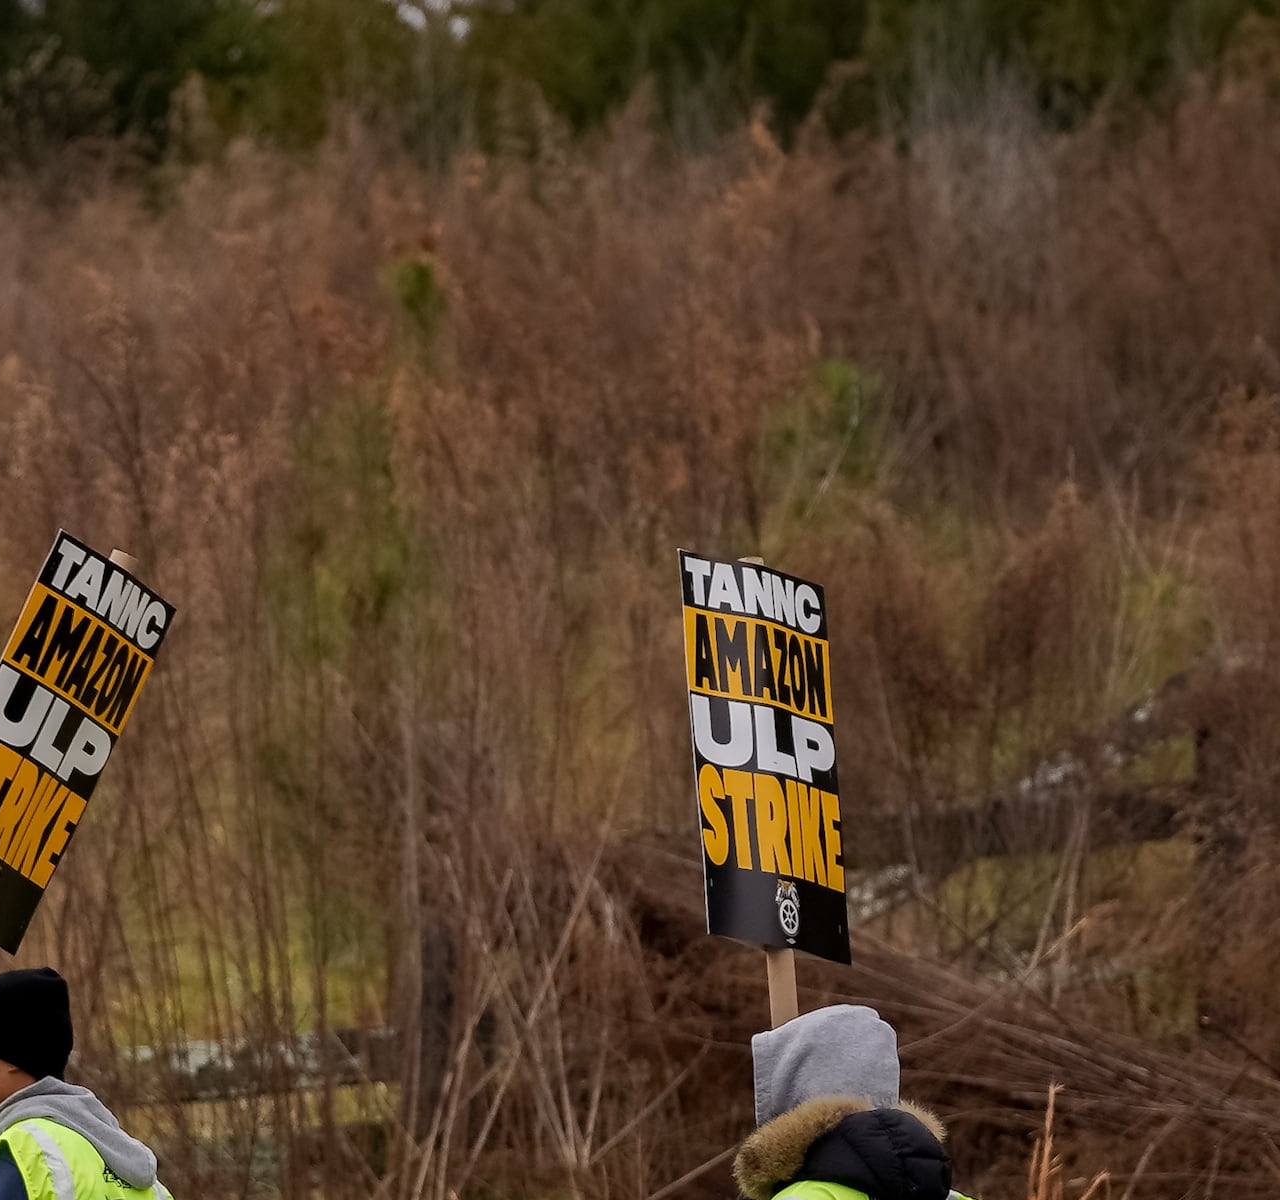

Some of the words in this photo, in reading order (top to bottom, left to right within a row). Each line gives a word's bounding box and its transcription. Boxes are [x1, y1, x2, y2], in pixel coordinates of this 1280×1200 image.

[51, 538, 167, 650] TANNC
[685, 556, 822, 634] TANNC
[10, 593, 149, 727] AMAZON
[695, 614, 828, 717] AMAZON
[691, 694, 836, 783] ULP
[699, 764, 845, 893] STRIKE
